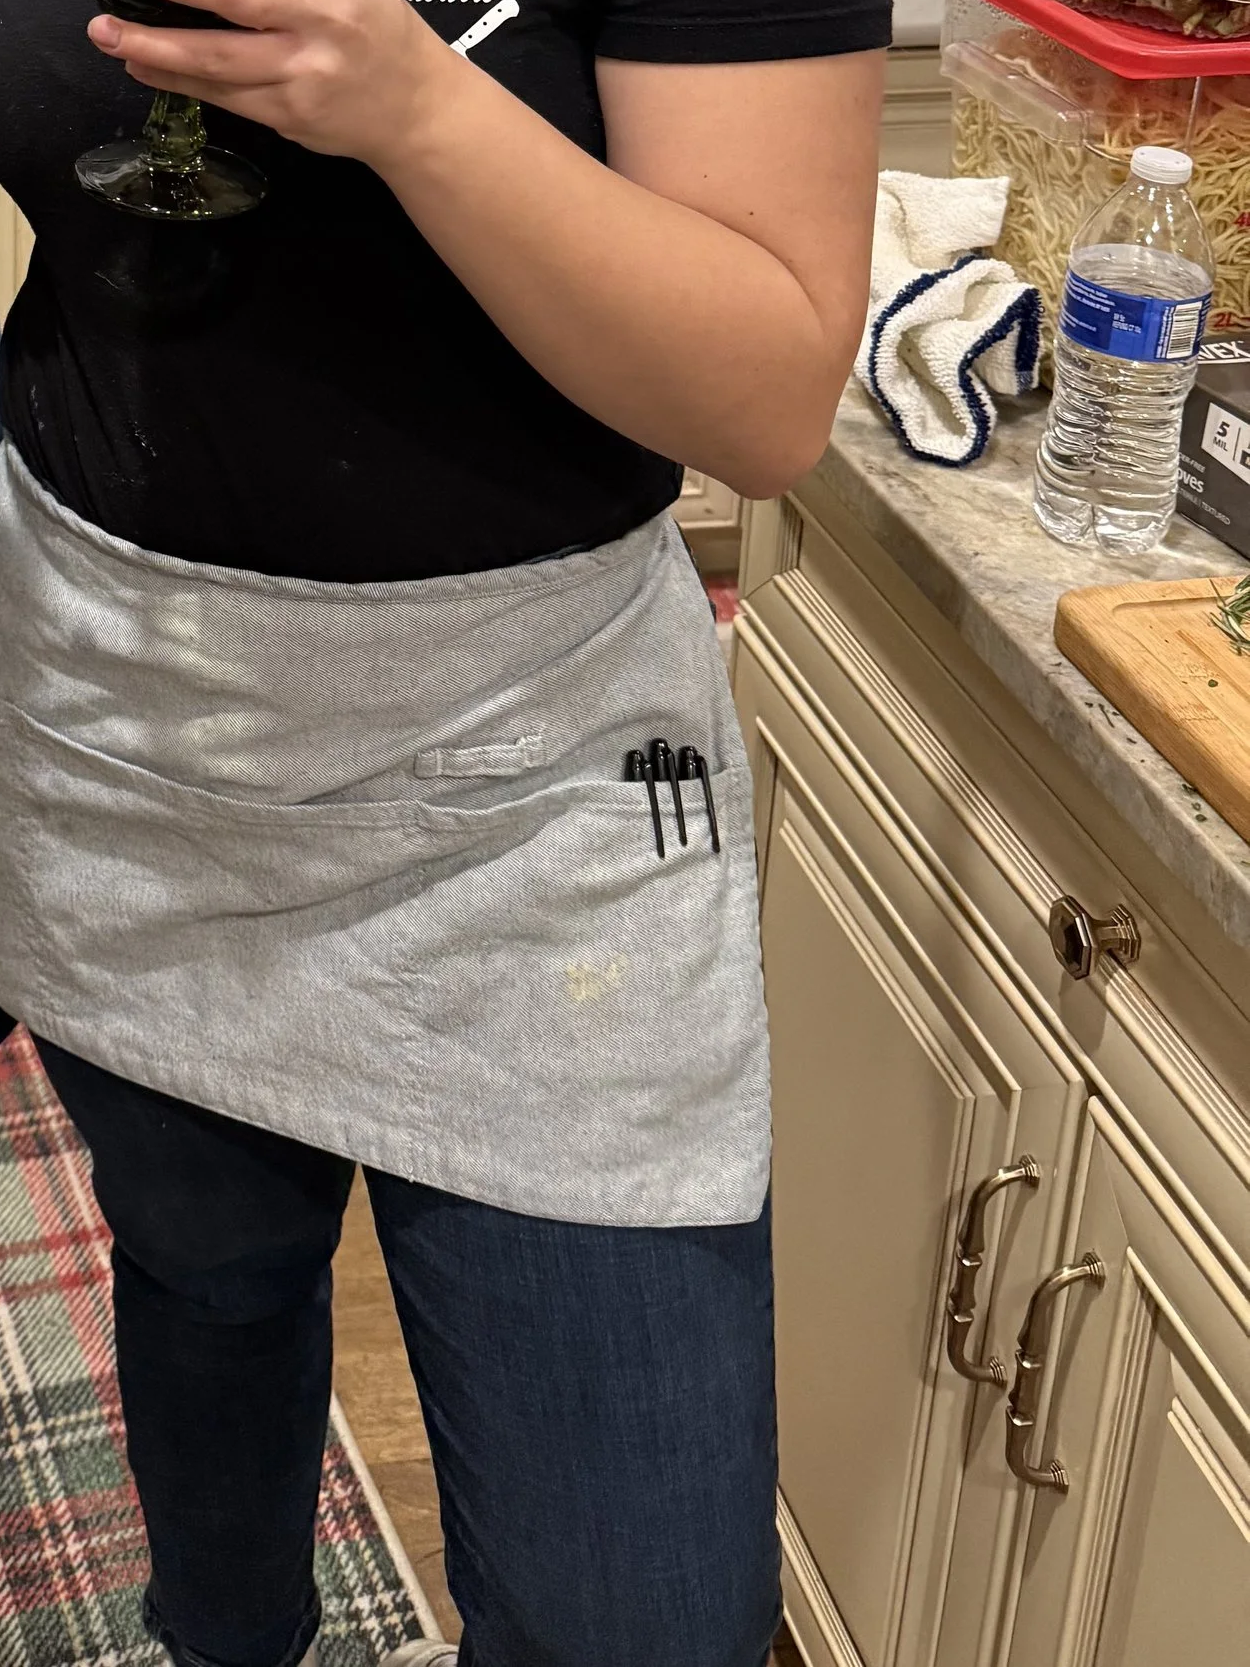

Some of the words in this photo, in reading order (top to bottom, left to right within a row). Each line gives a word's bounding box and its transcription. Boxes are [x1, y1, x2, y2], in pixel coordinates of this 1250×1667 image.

[1196, 340, 1250, 360] VEX
[1216, 420, 1231, 438] 5
[1212, 436, 1229, 452] MIL
[1177, 469, 1205, 494] oves
